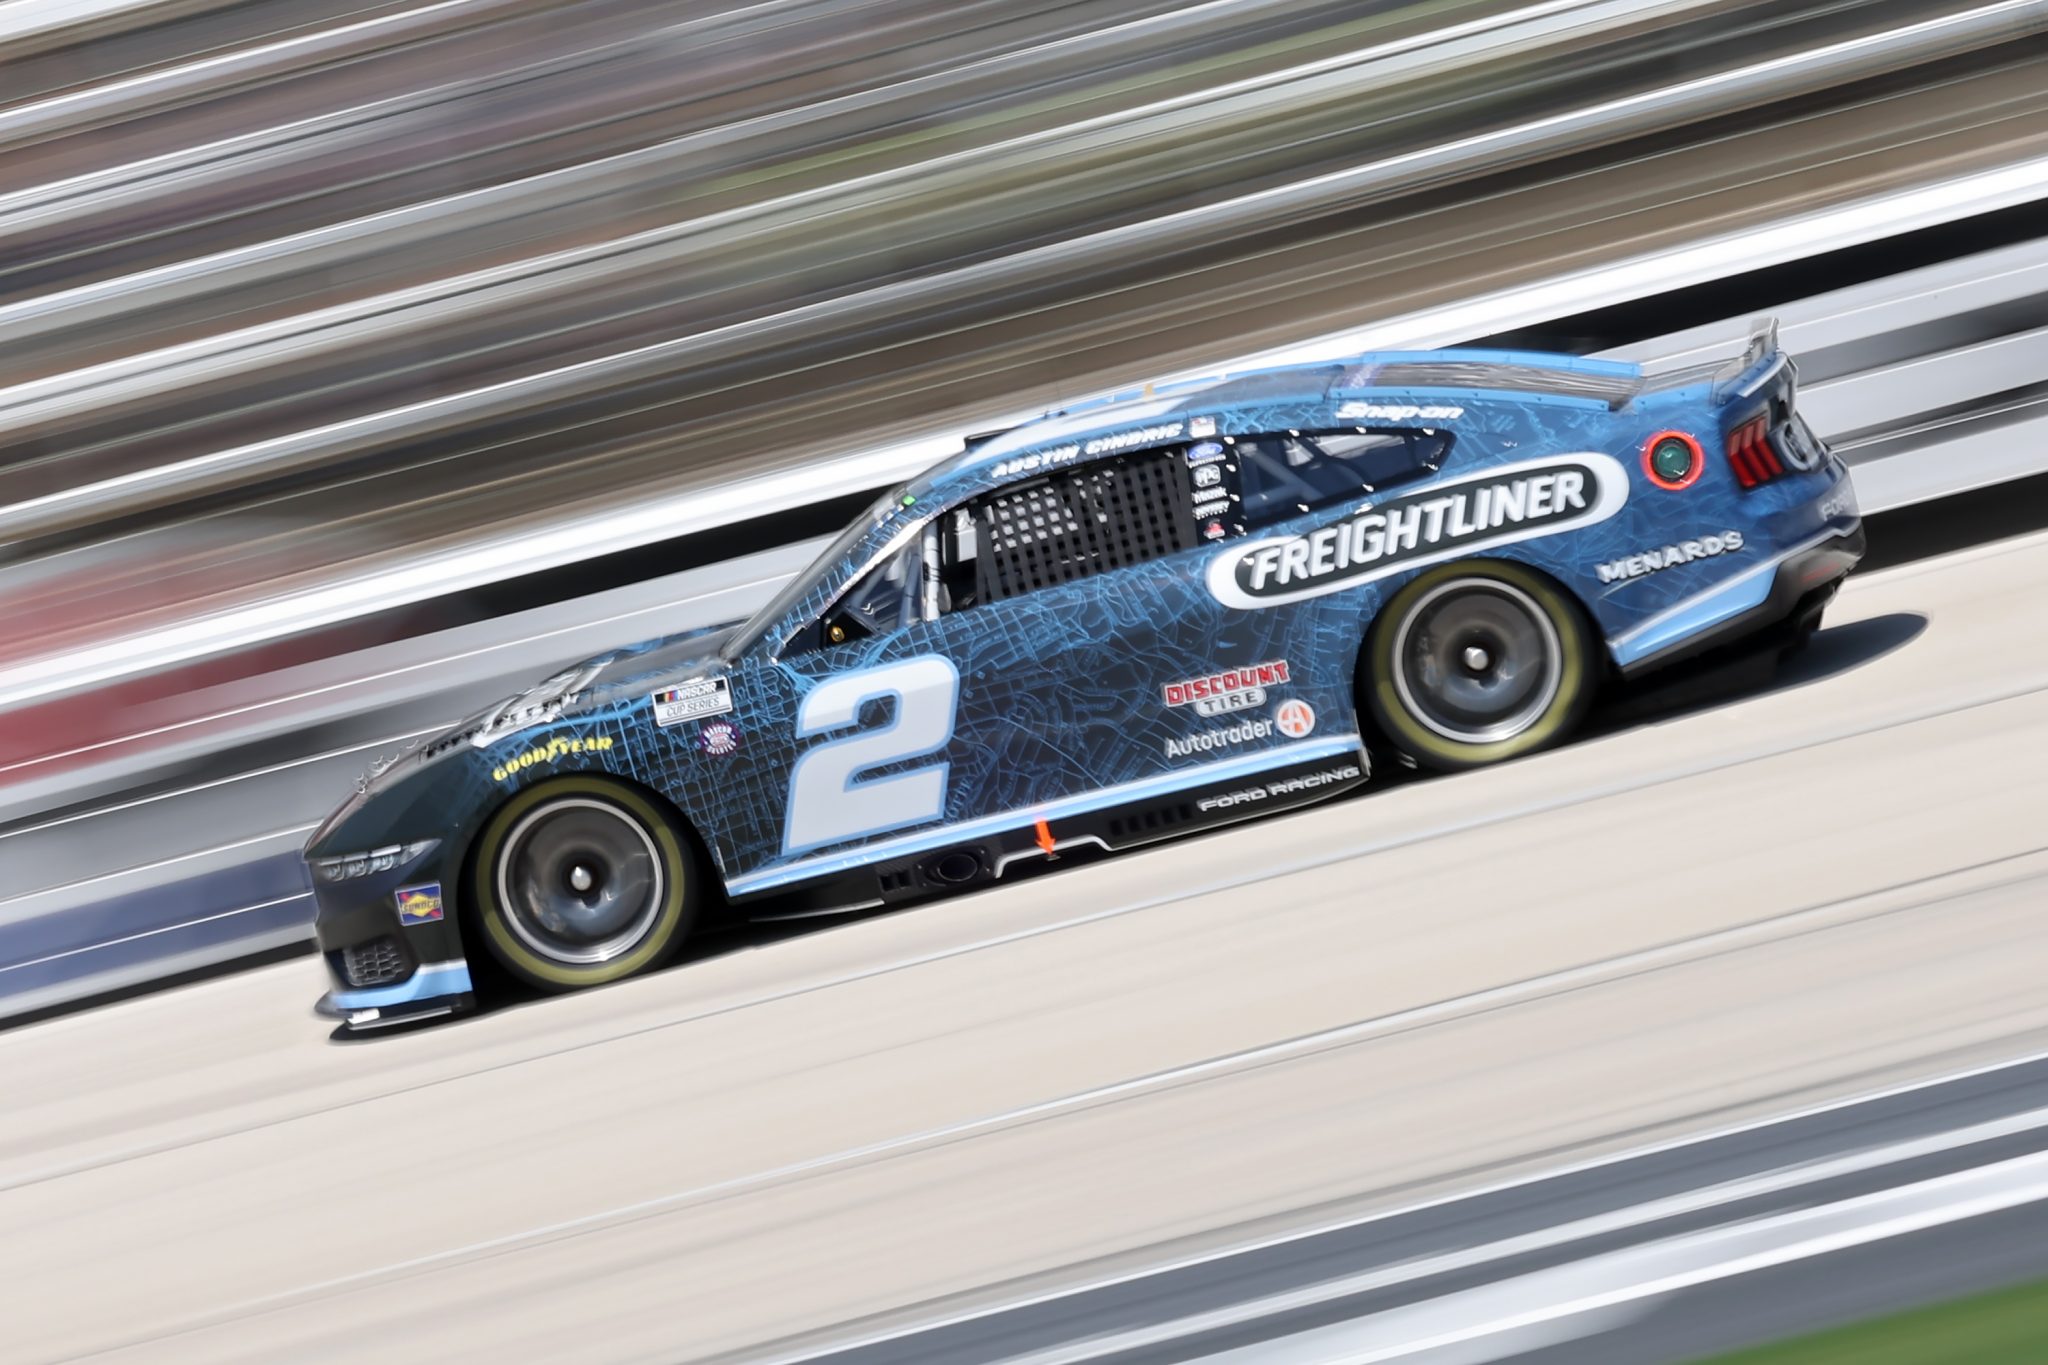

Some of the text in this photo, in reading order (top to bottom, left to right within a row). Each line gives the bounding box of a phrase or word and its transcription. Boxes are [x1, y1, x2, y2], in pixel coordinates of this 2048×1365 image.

[1335, 402, 1464, 421] Snap-on
[1249, 471, 1586, 590] FREIGHTLINER
[1596, 529, 1744, 583] MENARDS
[677, 682, 717, 700] NASCAR
[1163, 660, 1291, 707] DISCOUNT
[1204, 691, 1259, 712] TIRE
[666, 697, 720, 717] CUP SERIES
[493, 736, 613, 781] GOODYEAR
[781, 653, 960, 857] 2
[1167, 718, 1273, 759] Autotrader
[1200, 765, 1361, 812] FORD RACING
